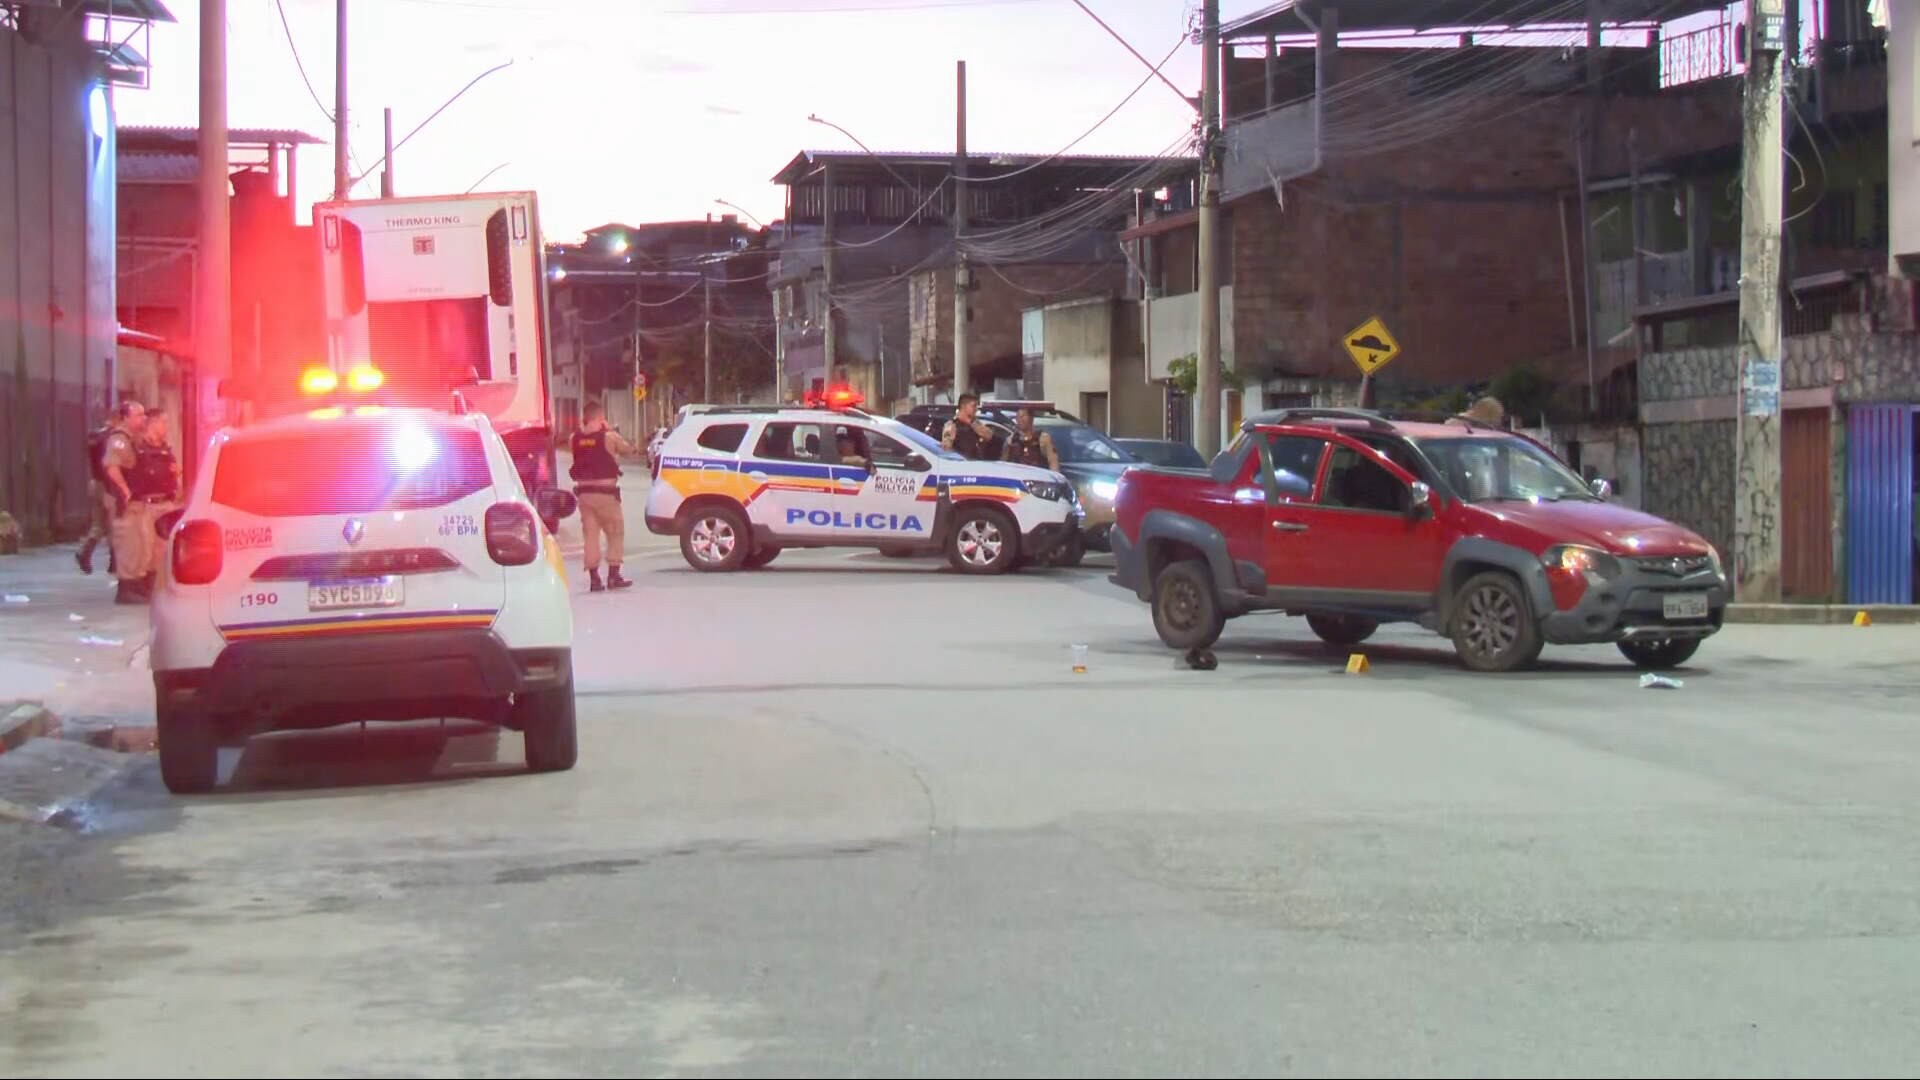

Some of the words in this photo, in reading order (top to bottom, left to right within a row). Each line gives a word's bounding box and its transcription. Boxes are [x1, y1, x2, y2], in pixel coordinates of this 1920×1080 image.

[385, 217, 432, 227] THERMO
[434, 215, 460, 224] KING
[874, 483, 915, 493] MILITAR
[786, 508, 923, 531] POLICIA
[457, 525, 478, 536] BPM
[247, 593, 278, 606] 190
